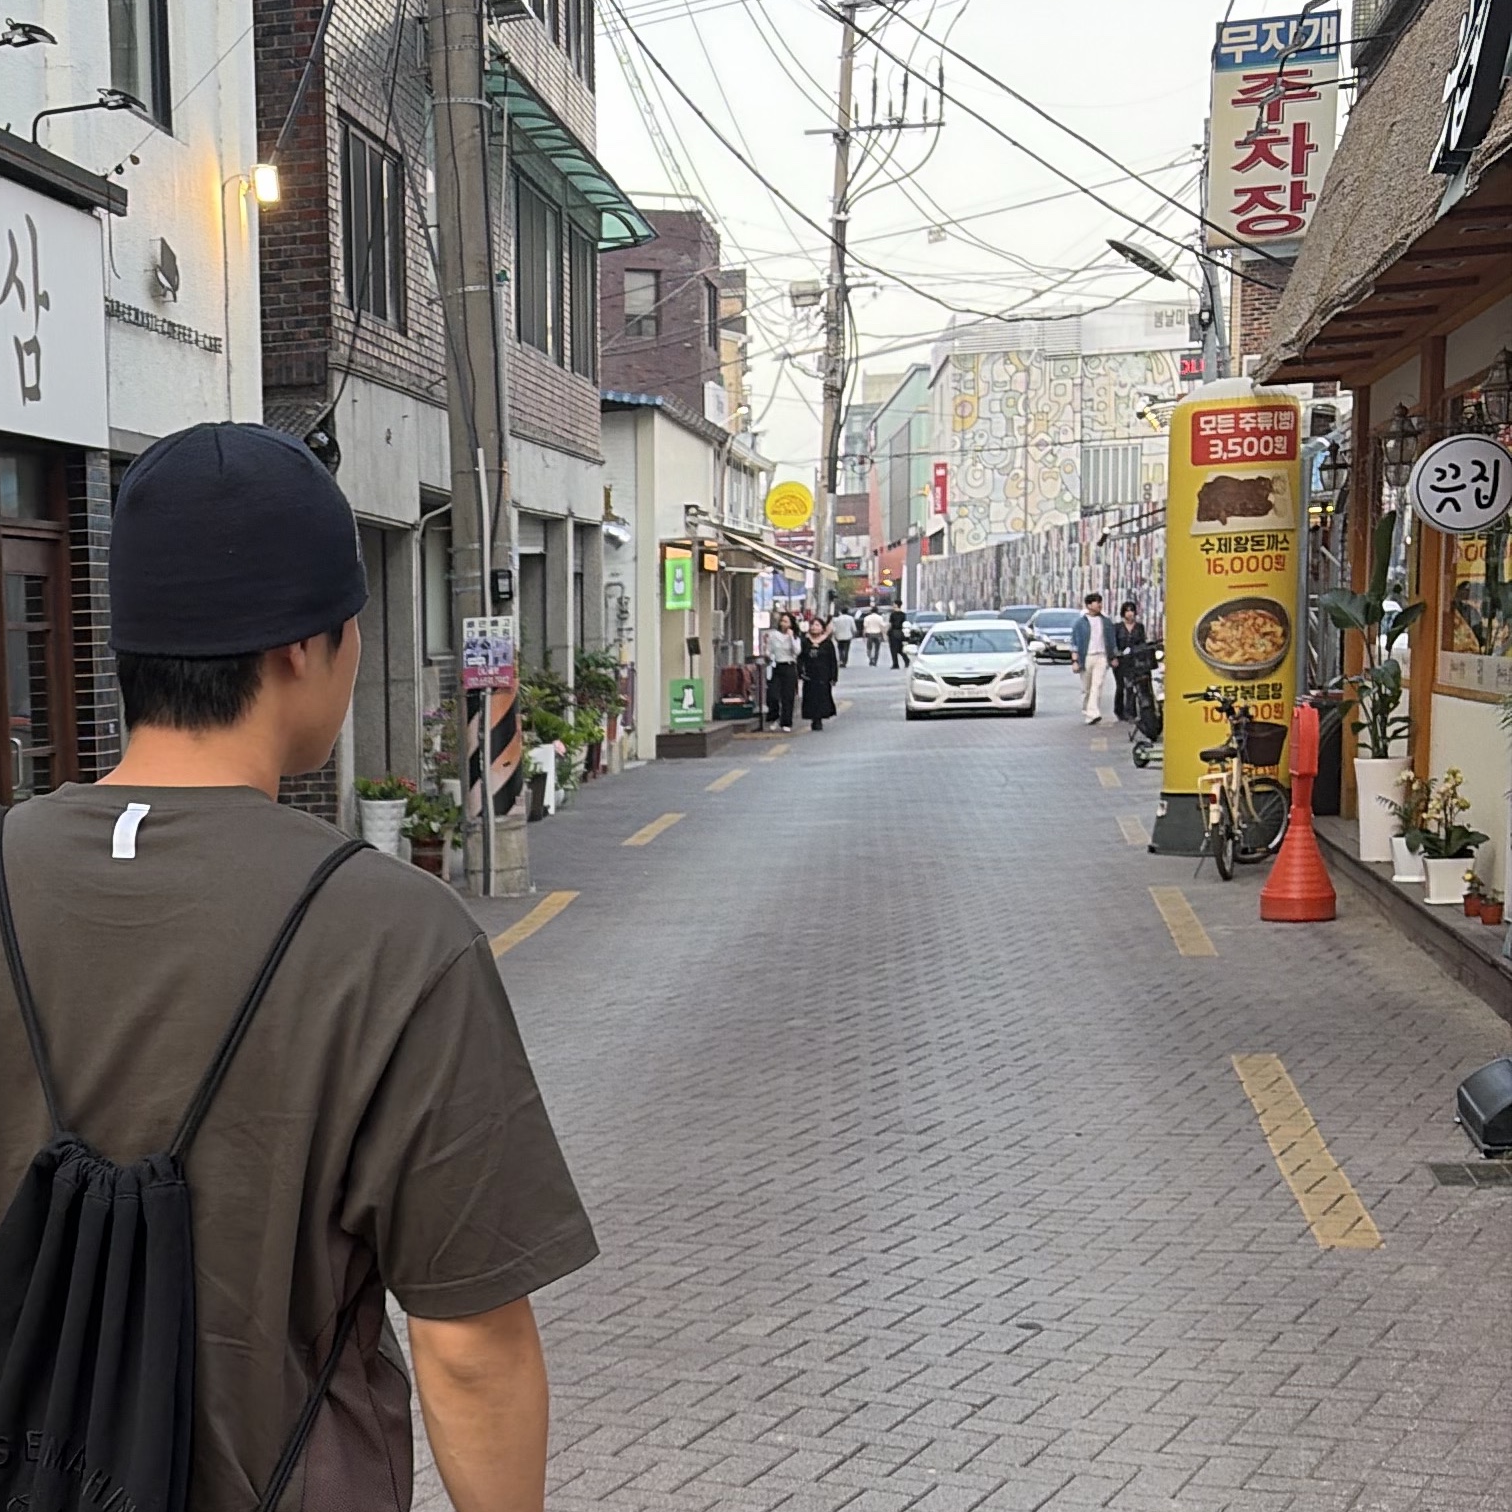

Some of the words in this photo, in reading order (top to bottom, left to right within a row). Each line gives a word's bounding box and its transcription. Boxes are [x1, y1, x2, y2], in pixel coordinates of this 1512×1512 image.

[1230, 68, 1320, 236] 주차장
[1200, 413, 1235, 436] 모든
[1209, 435, 1287, 460] 3,500원
[1200, 533, 1290, 554] 수제왕돈까스
[1206, 554, 1286, 577] 16,000원
[1207, 682, 1283, 702] 닭볶음탕
[1203, 702, 1285, 724] 10,00원
